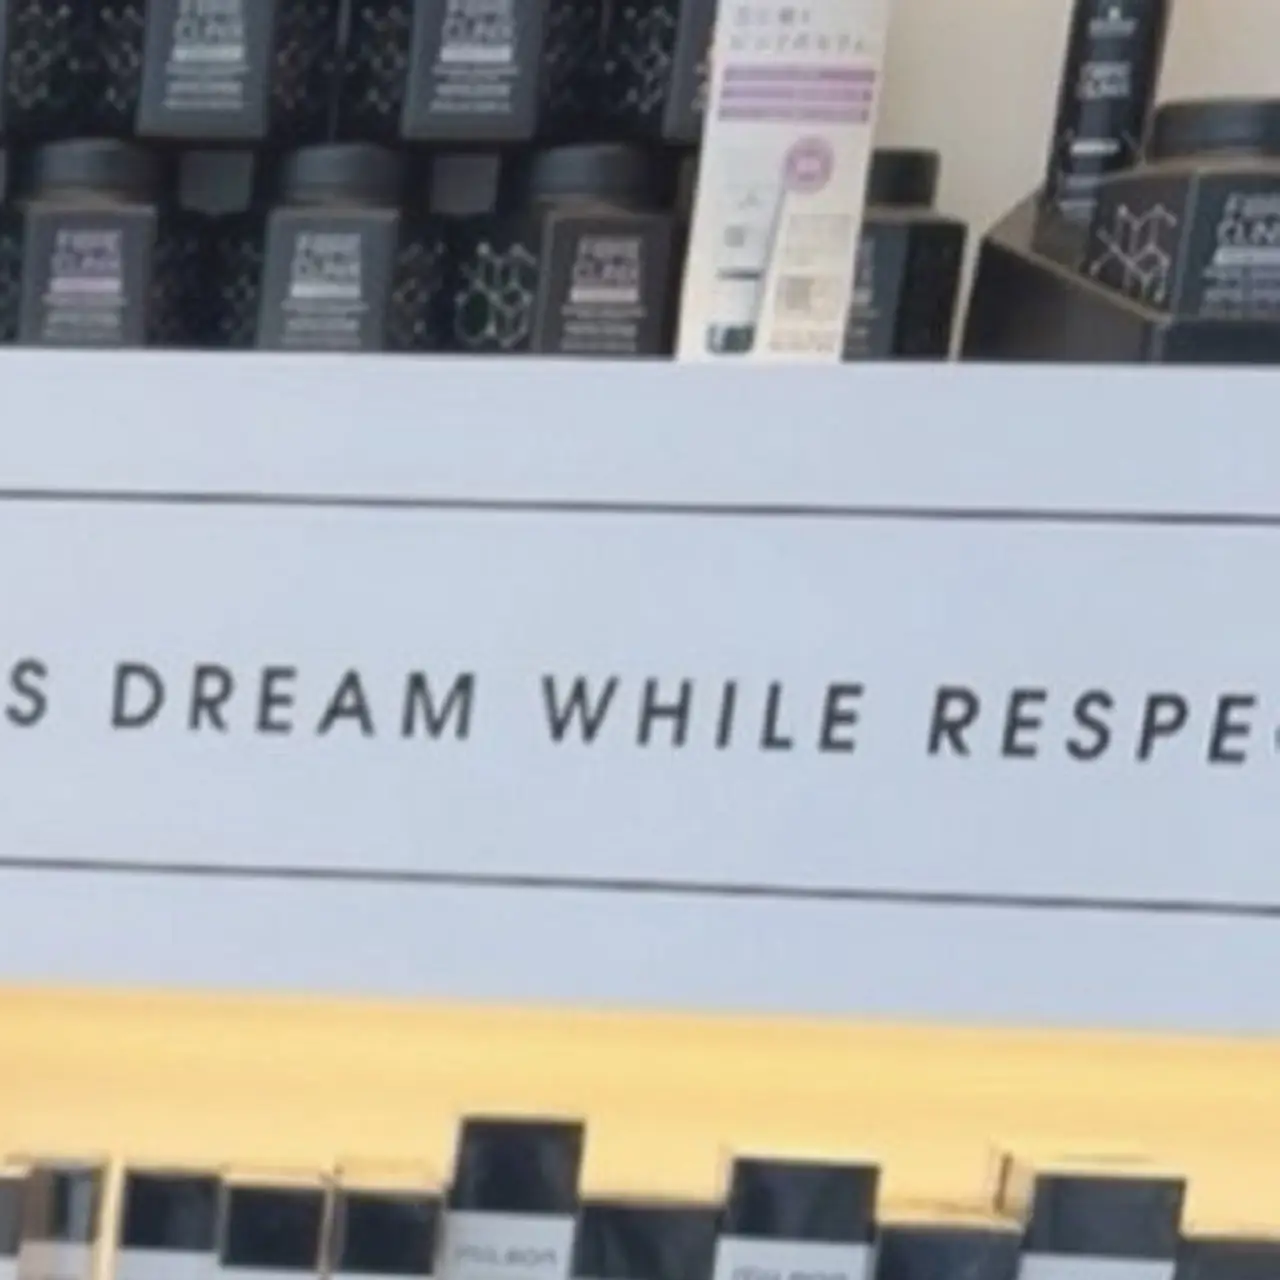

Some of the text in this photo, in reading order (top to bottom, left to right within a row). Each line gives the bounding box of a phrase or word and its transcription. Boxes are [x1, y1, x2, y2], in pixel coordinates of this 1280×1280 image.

[110, 660, 477, 742] DREAM
[540, 673, 867, 754] WHILE
[926, 684, 1280, 766] RESPE
